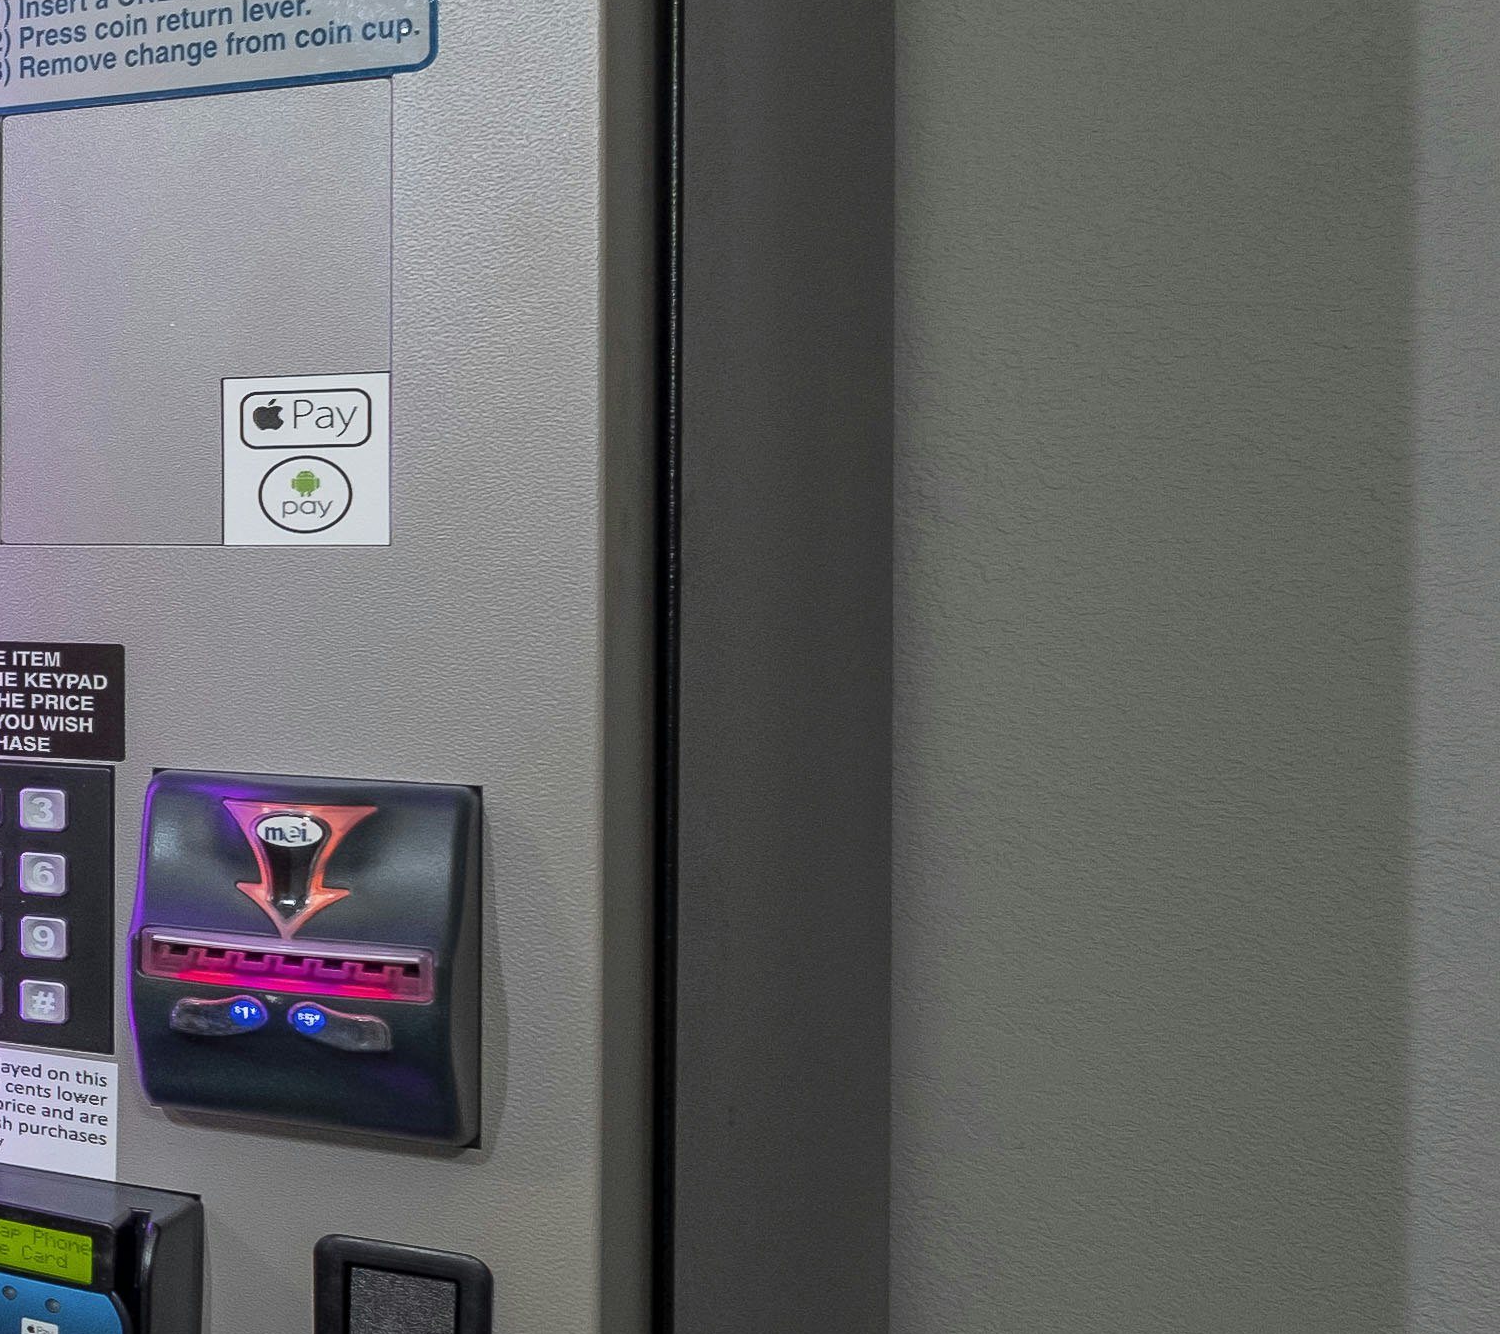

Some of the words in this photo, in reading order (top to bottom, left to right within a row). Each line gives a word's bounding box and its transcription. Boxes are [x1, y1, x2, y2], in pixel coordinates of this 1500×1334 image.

[19, 22, 87, 52] Press
[95, 13, 148, 41] coin
[156, 3, 234, 35] return
[19, 49, 118, 80] Remove
[124, 34, 218, 70] change
[226, 26, 287, 56] from
[294, 22, 353, 49] coin
[361, 18, 421, 44] cup.
[293, 399, 358, 437] Pay
[282, 500, 334, 518] pay
[11, 651, 61, 668] ITEM
[24, 672, 108, 690] KEYPAD
[31, 693, 95, 712] PRICE
[40, 715, 94, 734] WISH
[47, 1068, 70, 1083] on
[75, 1070, 108, 1087] this
[5, 1081, 51, 1099] cents
[57, 1086, 108, 1106] lower
[41, 1105, 74, 1122] and
[79, 1112, 109, 1126] are
[18, 1122, 108, 1146] purchases
[33, 1229, 92, 1256] Phone
[21, 1244, 69, 1269] Card
